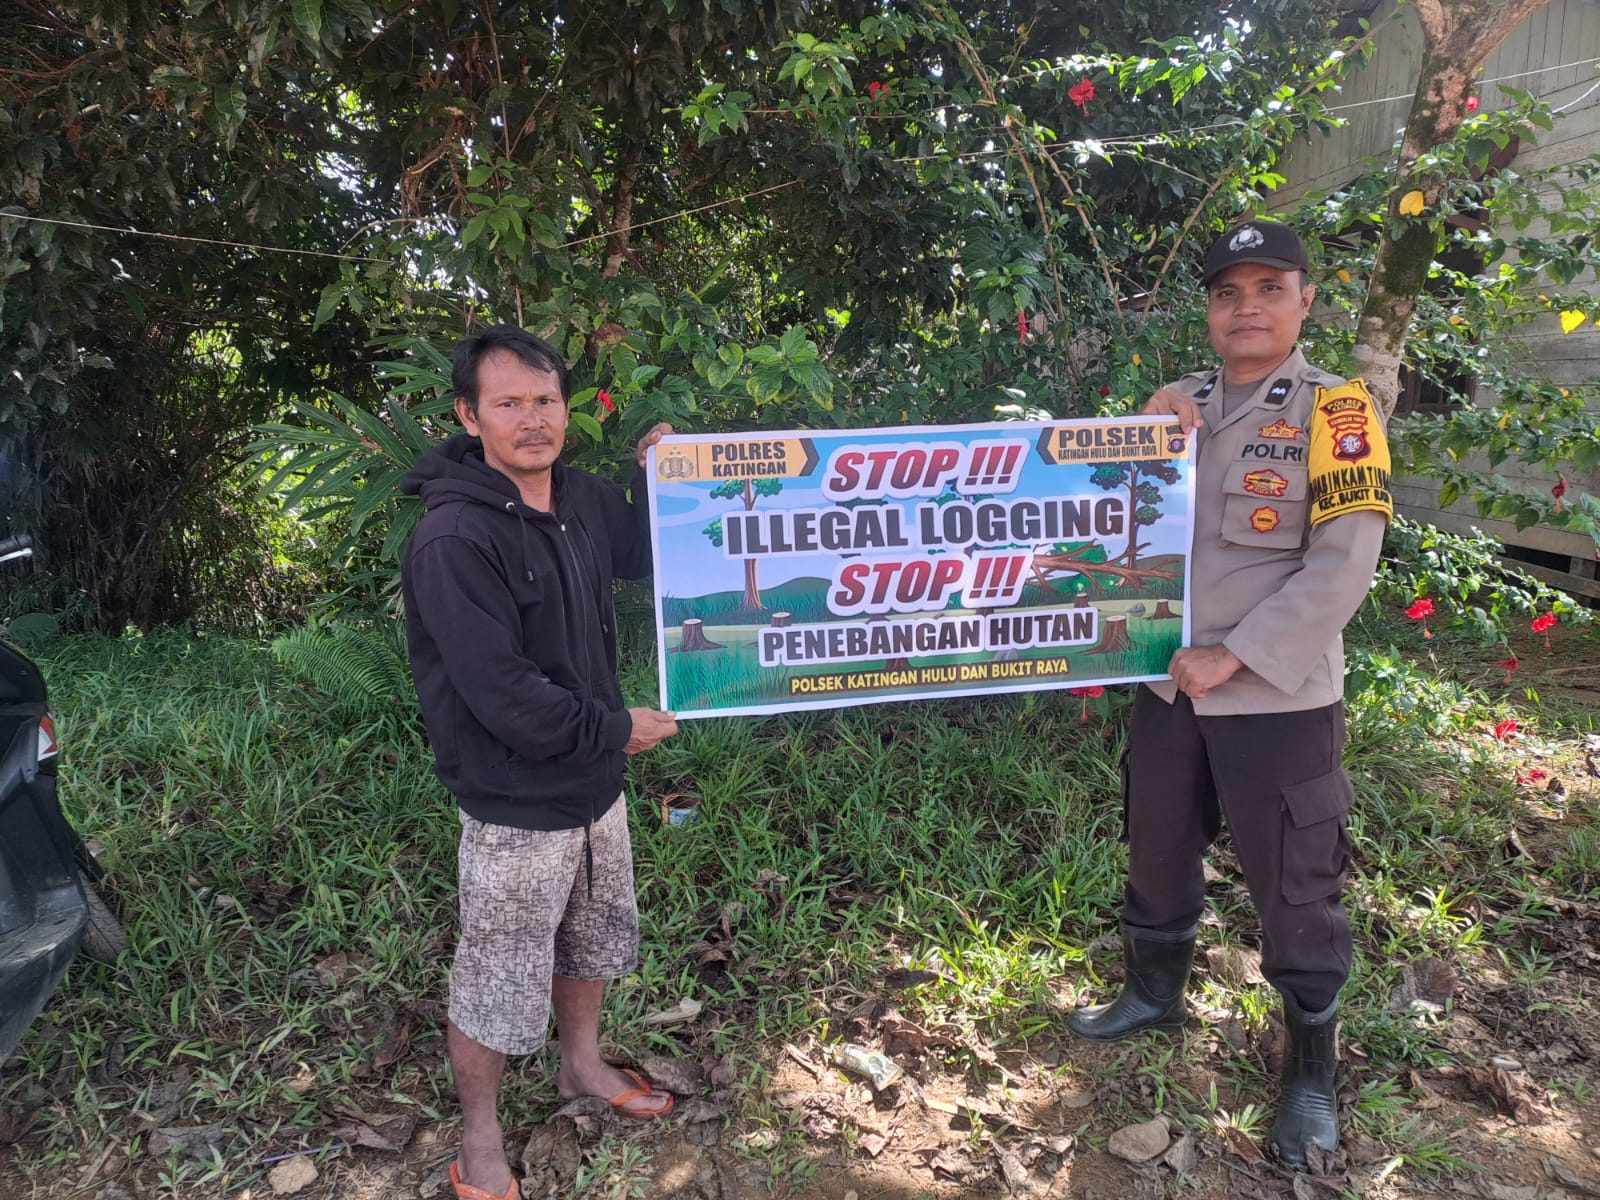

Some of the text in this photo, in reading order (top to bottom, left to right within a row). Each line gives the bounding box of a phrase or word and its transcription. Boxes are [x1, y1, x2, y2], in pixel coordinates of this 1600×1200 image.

[1059, 426, 1155, 448] POLSEK
[711, 441, 786, 462] POLRES
[1059, 445, 1157, 460] KATINGAN HULU DAN BUKIT RAYA
[1241, 443, 1304, 461] POLRI
[712, 461, 787, 477] KATINGAN
[829, 445, 1022, 492] STOP !!!
[726, 498, 1124, 555] ILLEGAL LOGGING
[834, 556, 1027, 607] STOP !!!
[763, 612, 1094, 662] PENEBANGAN HUTAN
[791, 658, 1068, 693] POLSEK KATINGAN HULU DAN BUKIT RAYA
